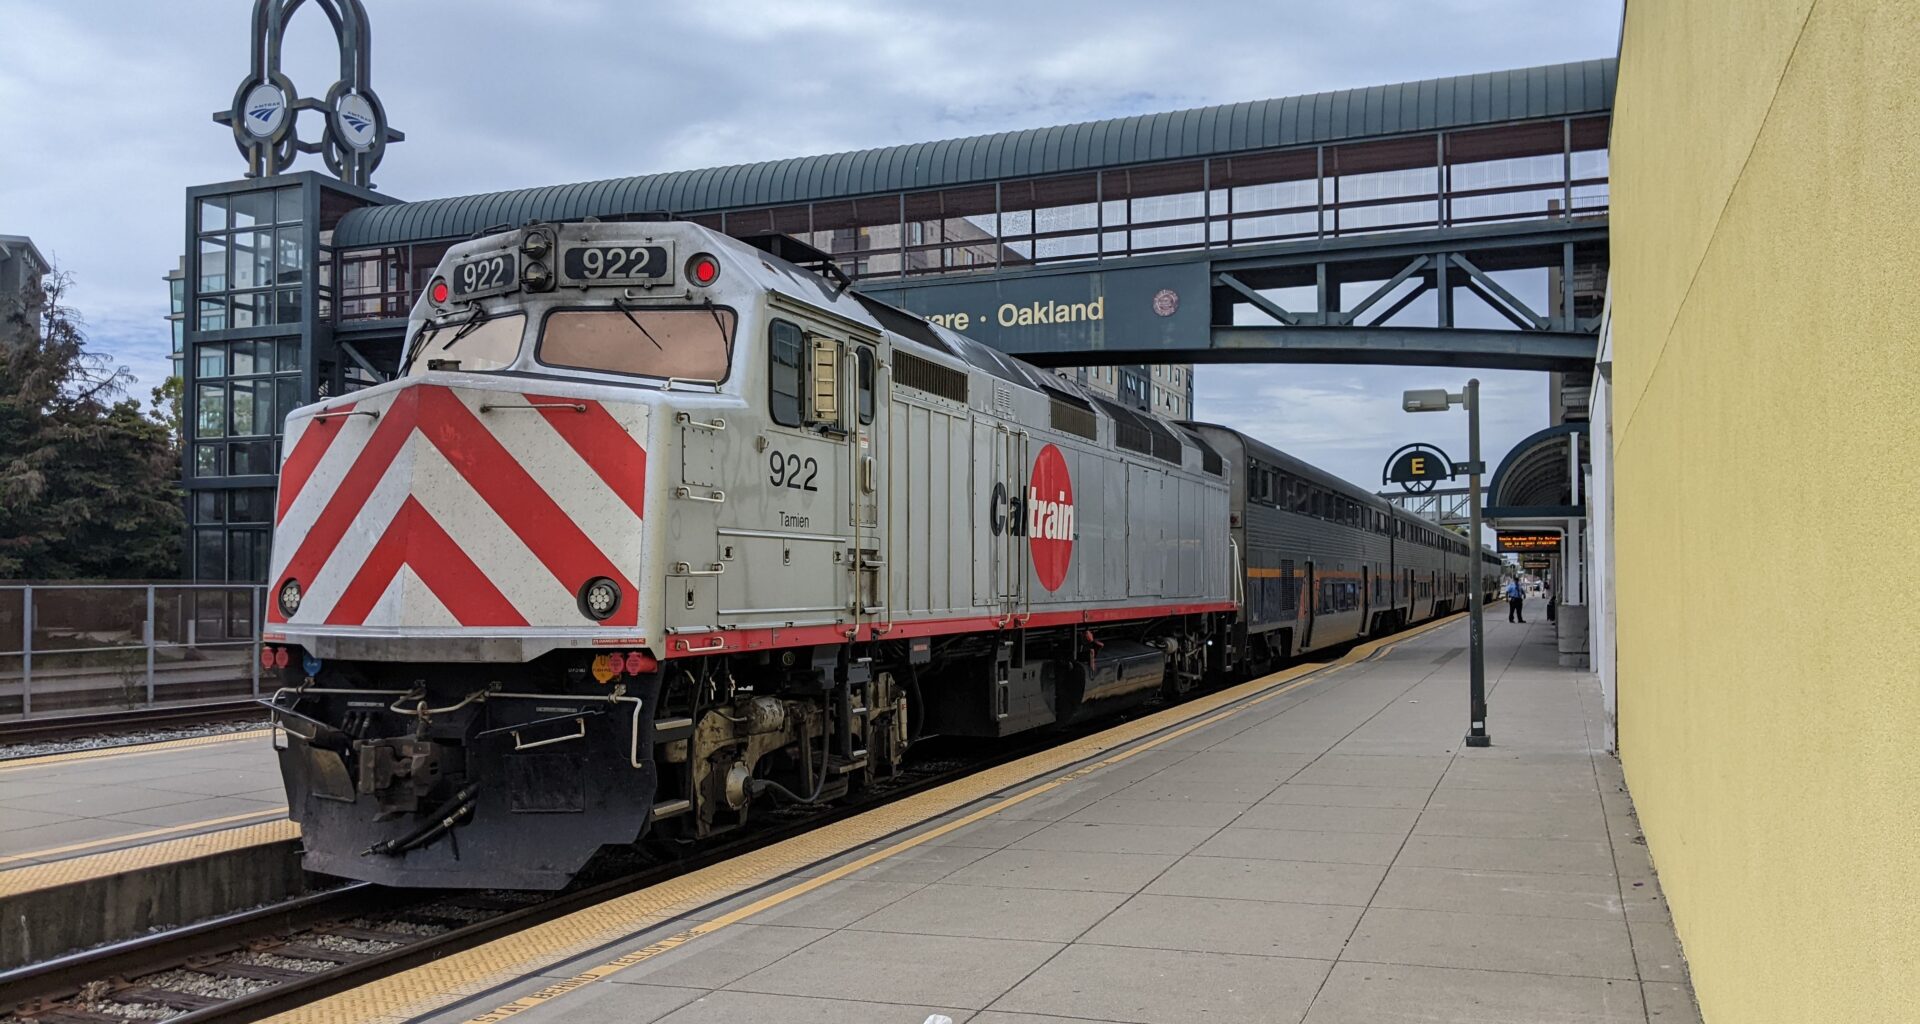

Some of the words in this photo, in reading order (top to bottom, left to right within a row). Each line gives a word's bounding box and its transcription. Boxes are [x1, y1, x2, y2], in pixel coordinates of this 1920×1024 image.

[347, 111, 372, 122] AMTRAK
[463, 257, 504, 292] 922
[583, 248, 650, 279] 922
[926, 311, 969, 331] are
[998, 296, 1104, 327] Oakland
[769, 450, 818, 492] 922
[1411, 458, 1425, 475] E
[779, 511, 810, 528] Tamien
[990, 481, 1074, 541] Caltrain
[472, 1001, 531, 1022] STAY
[528, 973, 600, 999] BEHIND
